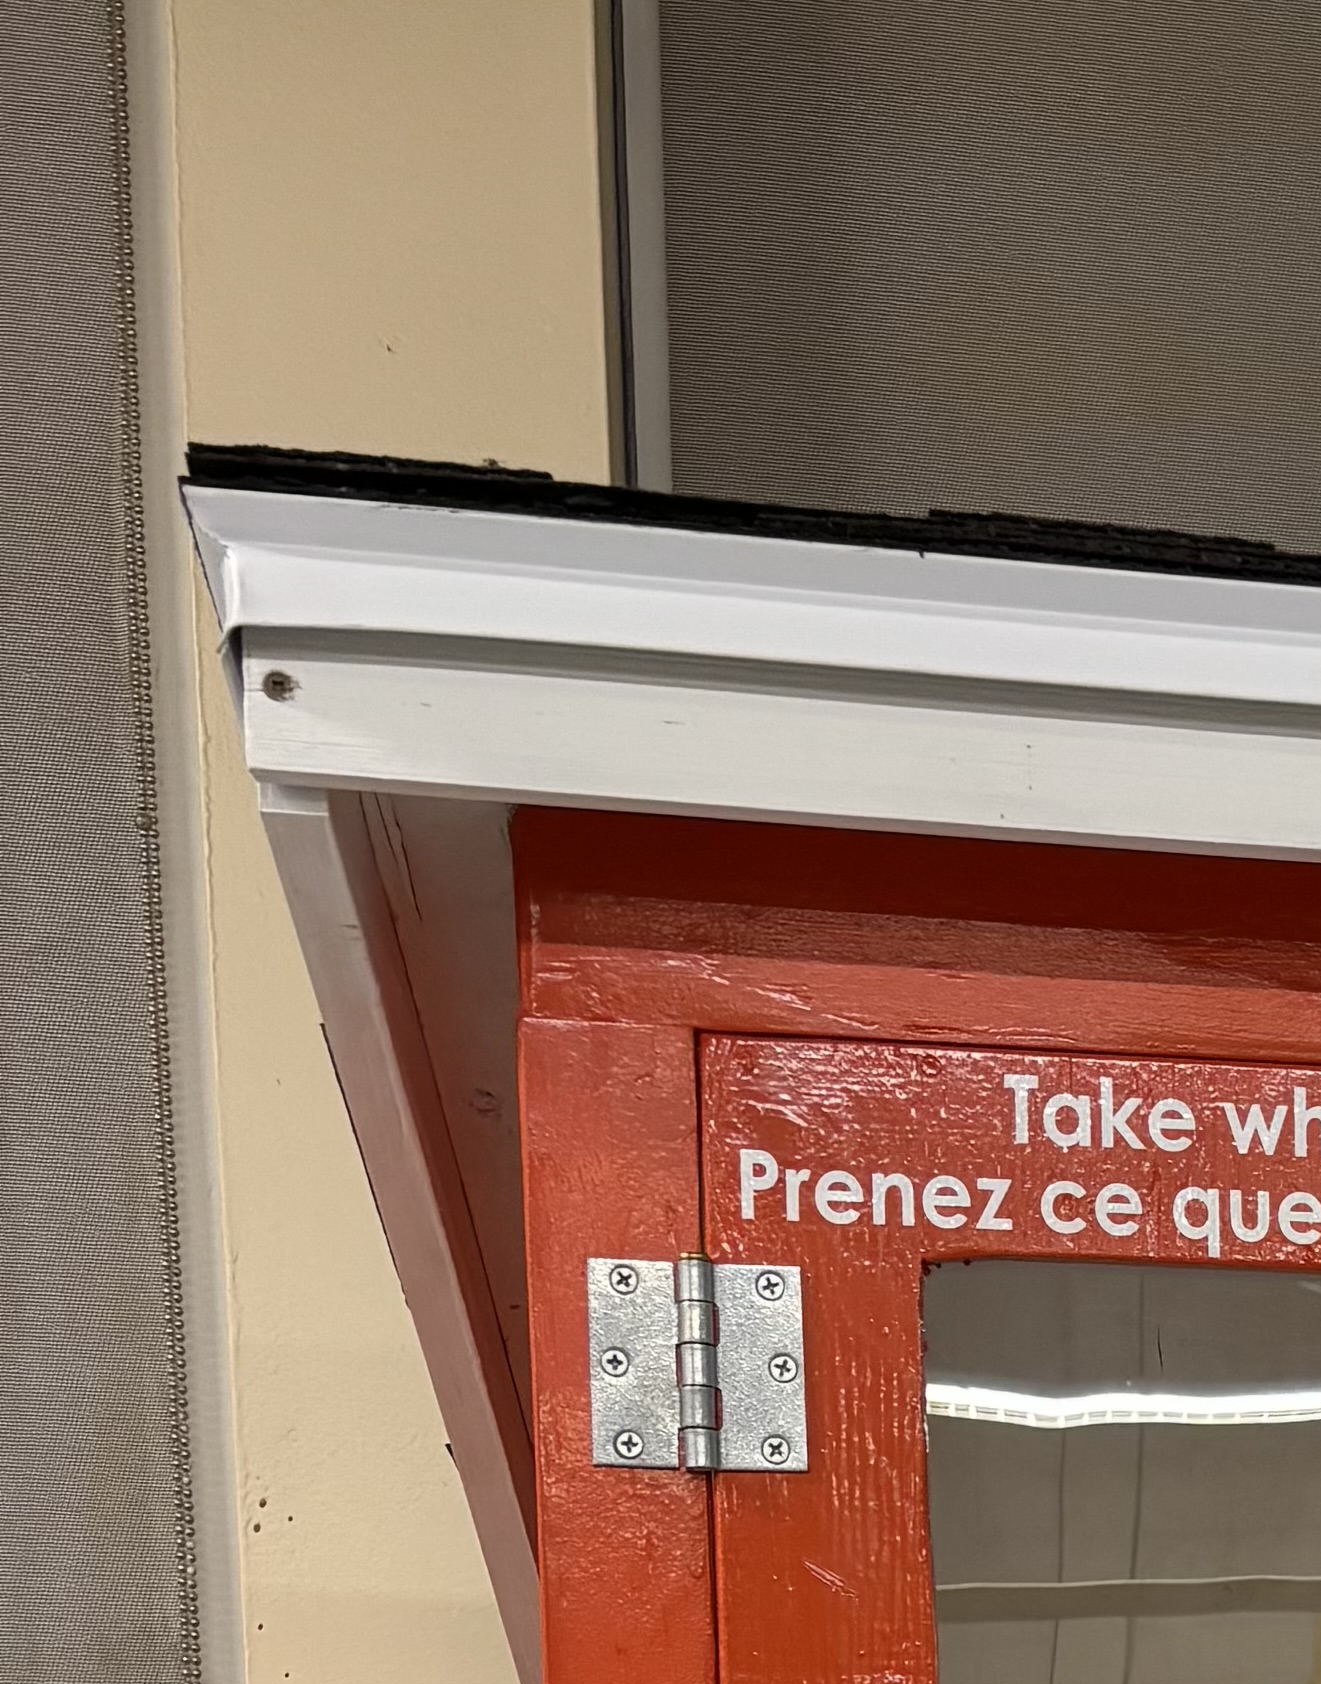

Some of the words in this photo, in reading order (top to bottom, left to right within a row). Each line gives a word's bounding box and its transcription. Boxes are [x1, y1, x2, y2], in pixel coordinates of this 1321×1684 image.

[1003, 1073, 1197, 1153] Take
[739, 1147, 1013, 1232] Prenez
[1040, 1180, 1144, 1237] ce
